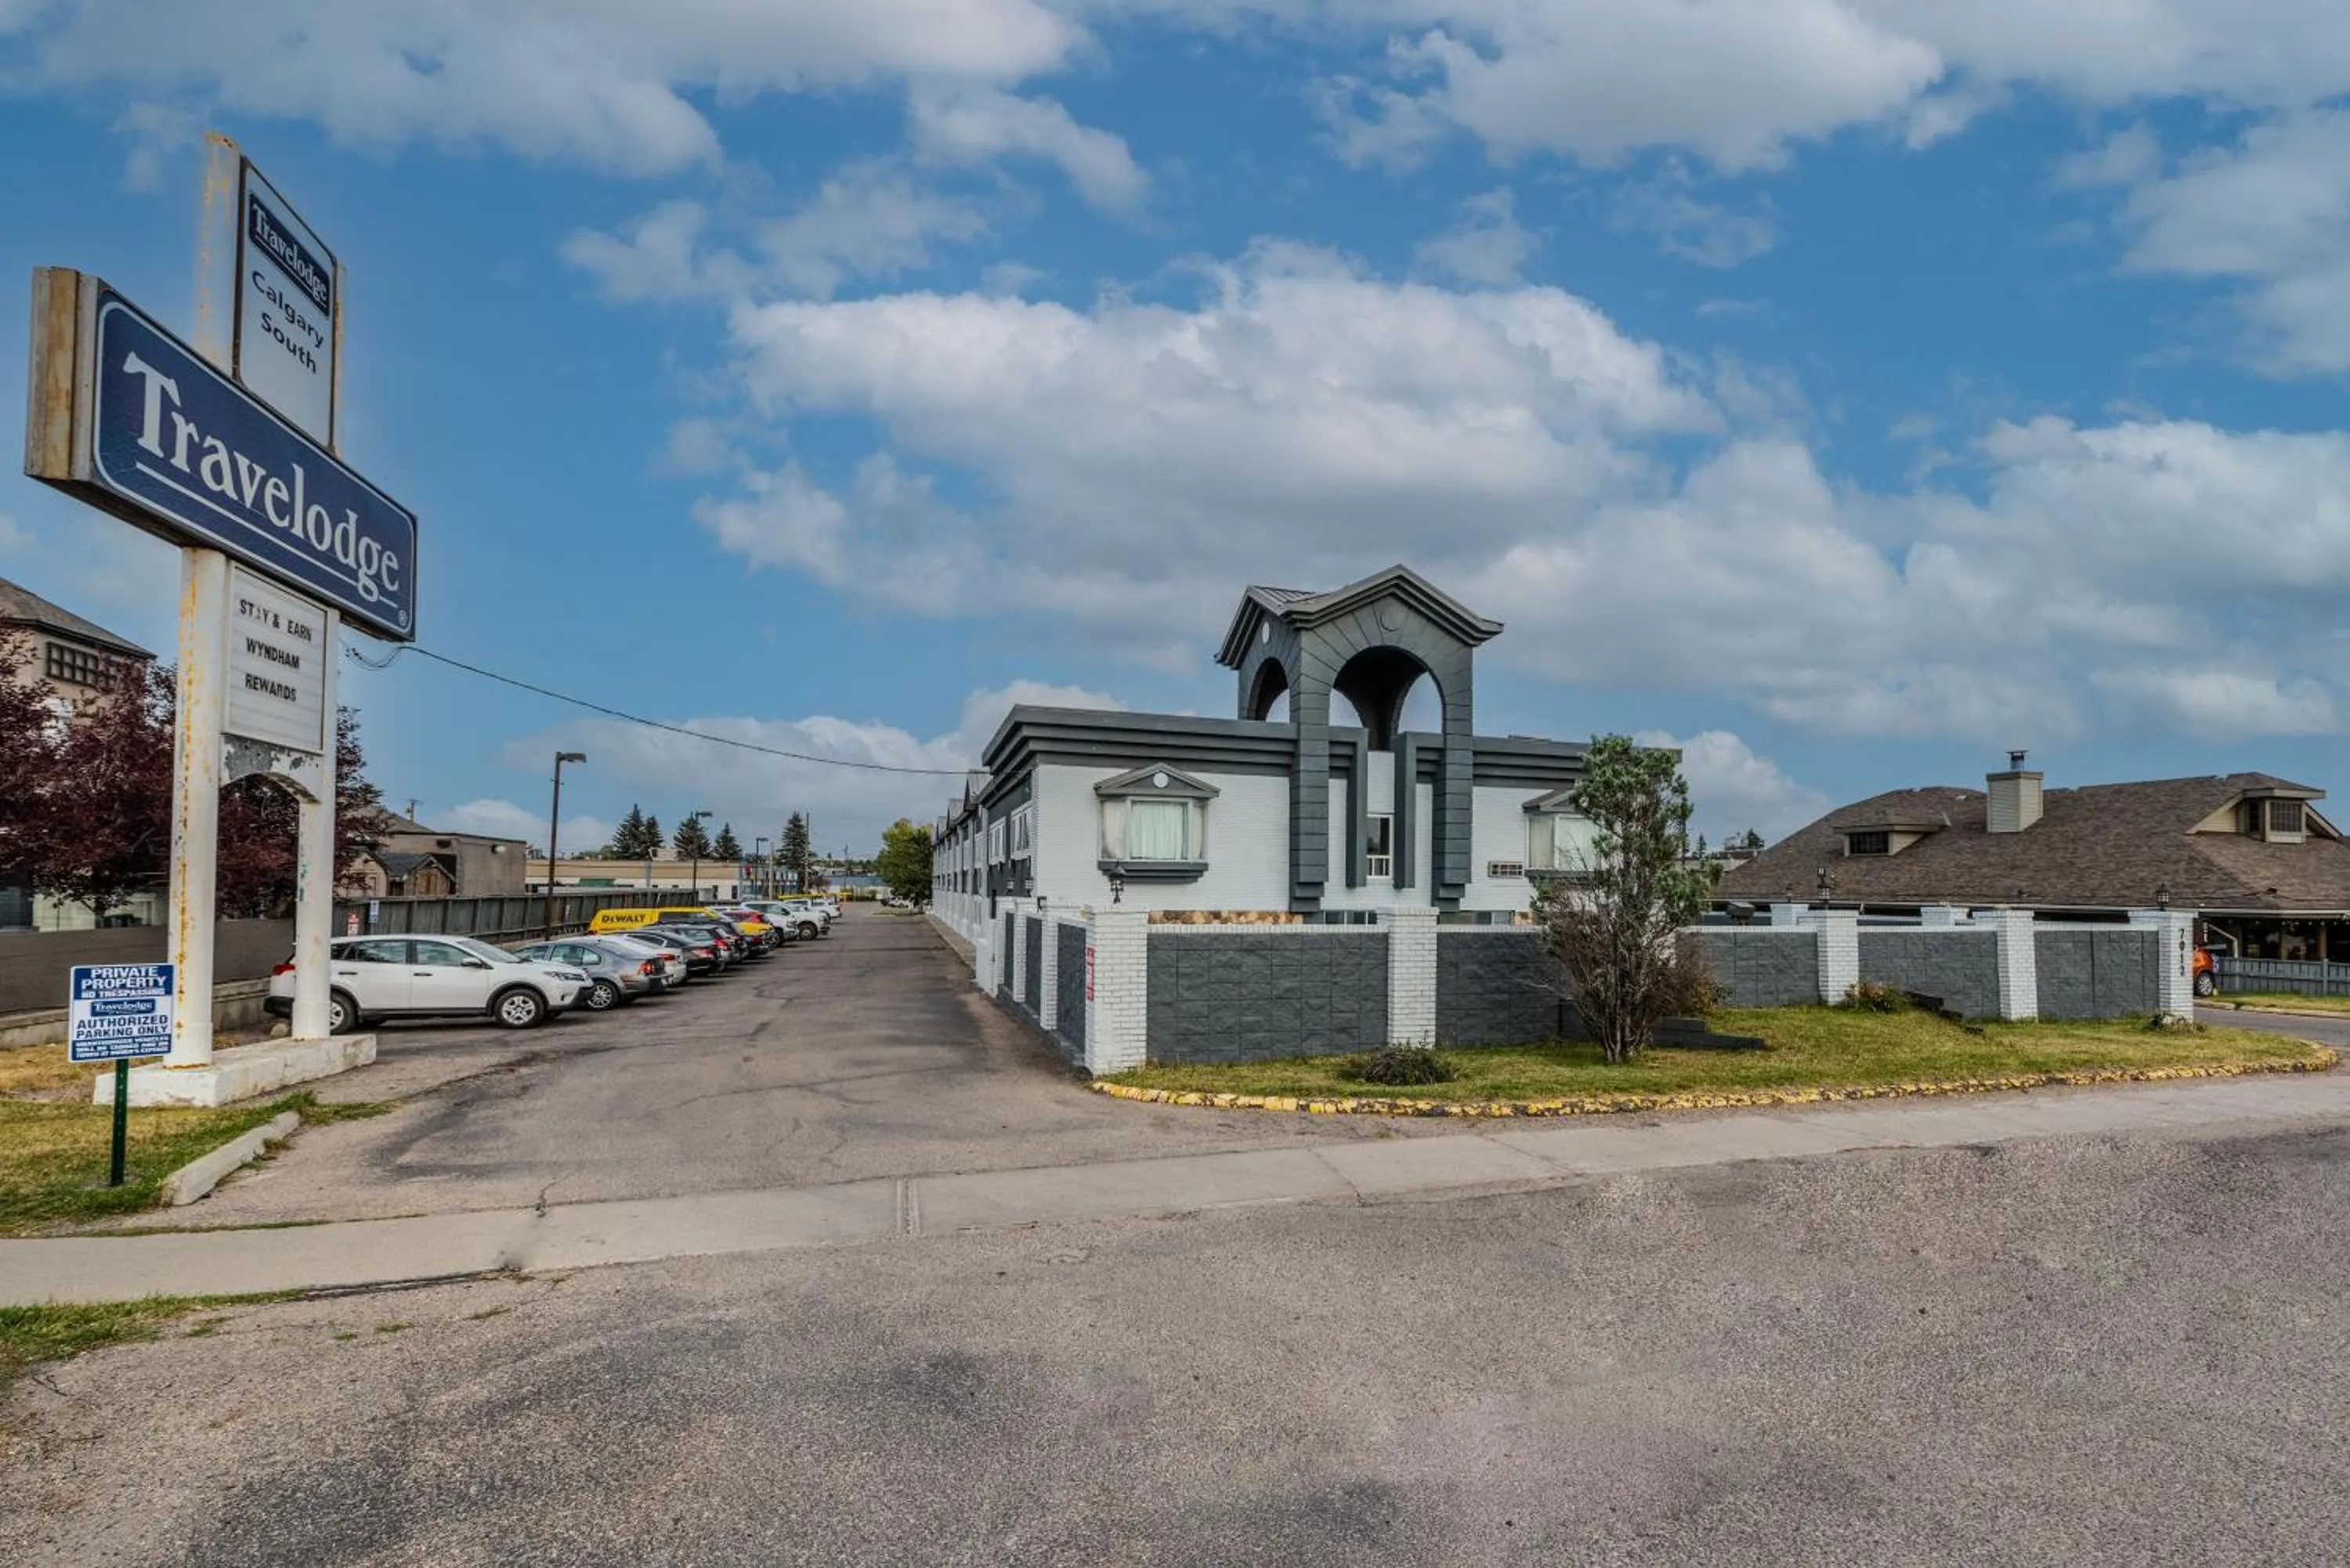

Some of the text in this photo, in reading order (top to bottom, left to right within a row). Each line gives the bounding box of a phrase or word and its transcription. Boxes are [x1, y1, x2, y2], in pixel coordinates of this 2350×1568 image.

[253, 203, 327, 302] Travelodge
[252, 270, 324, 349] Calgary
[261, 312, 316, 374] South
[123, 351, 400, 602] Travelodge
[288, 619, 312, 641] EARN
[245, 637, 300, 669] WYNDHAM
[245, 673, 297, 702] REWARDS
[81, 975, 167, 989] PROPERTY
[91, 966, 159, 978] PRIVATE
[76, 1025, 168, 1039] PARKING ONLY
[77, 1014, 168, 1029] AUTHORIZED
